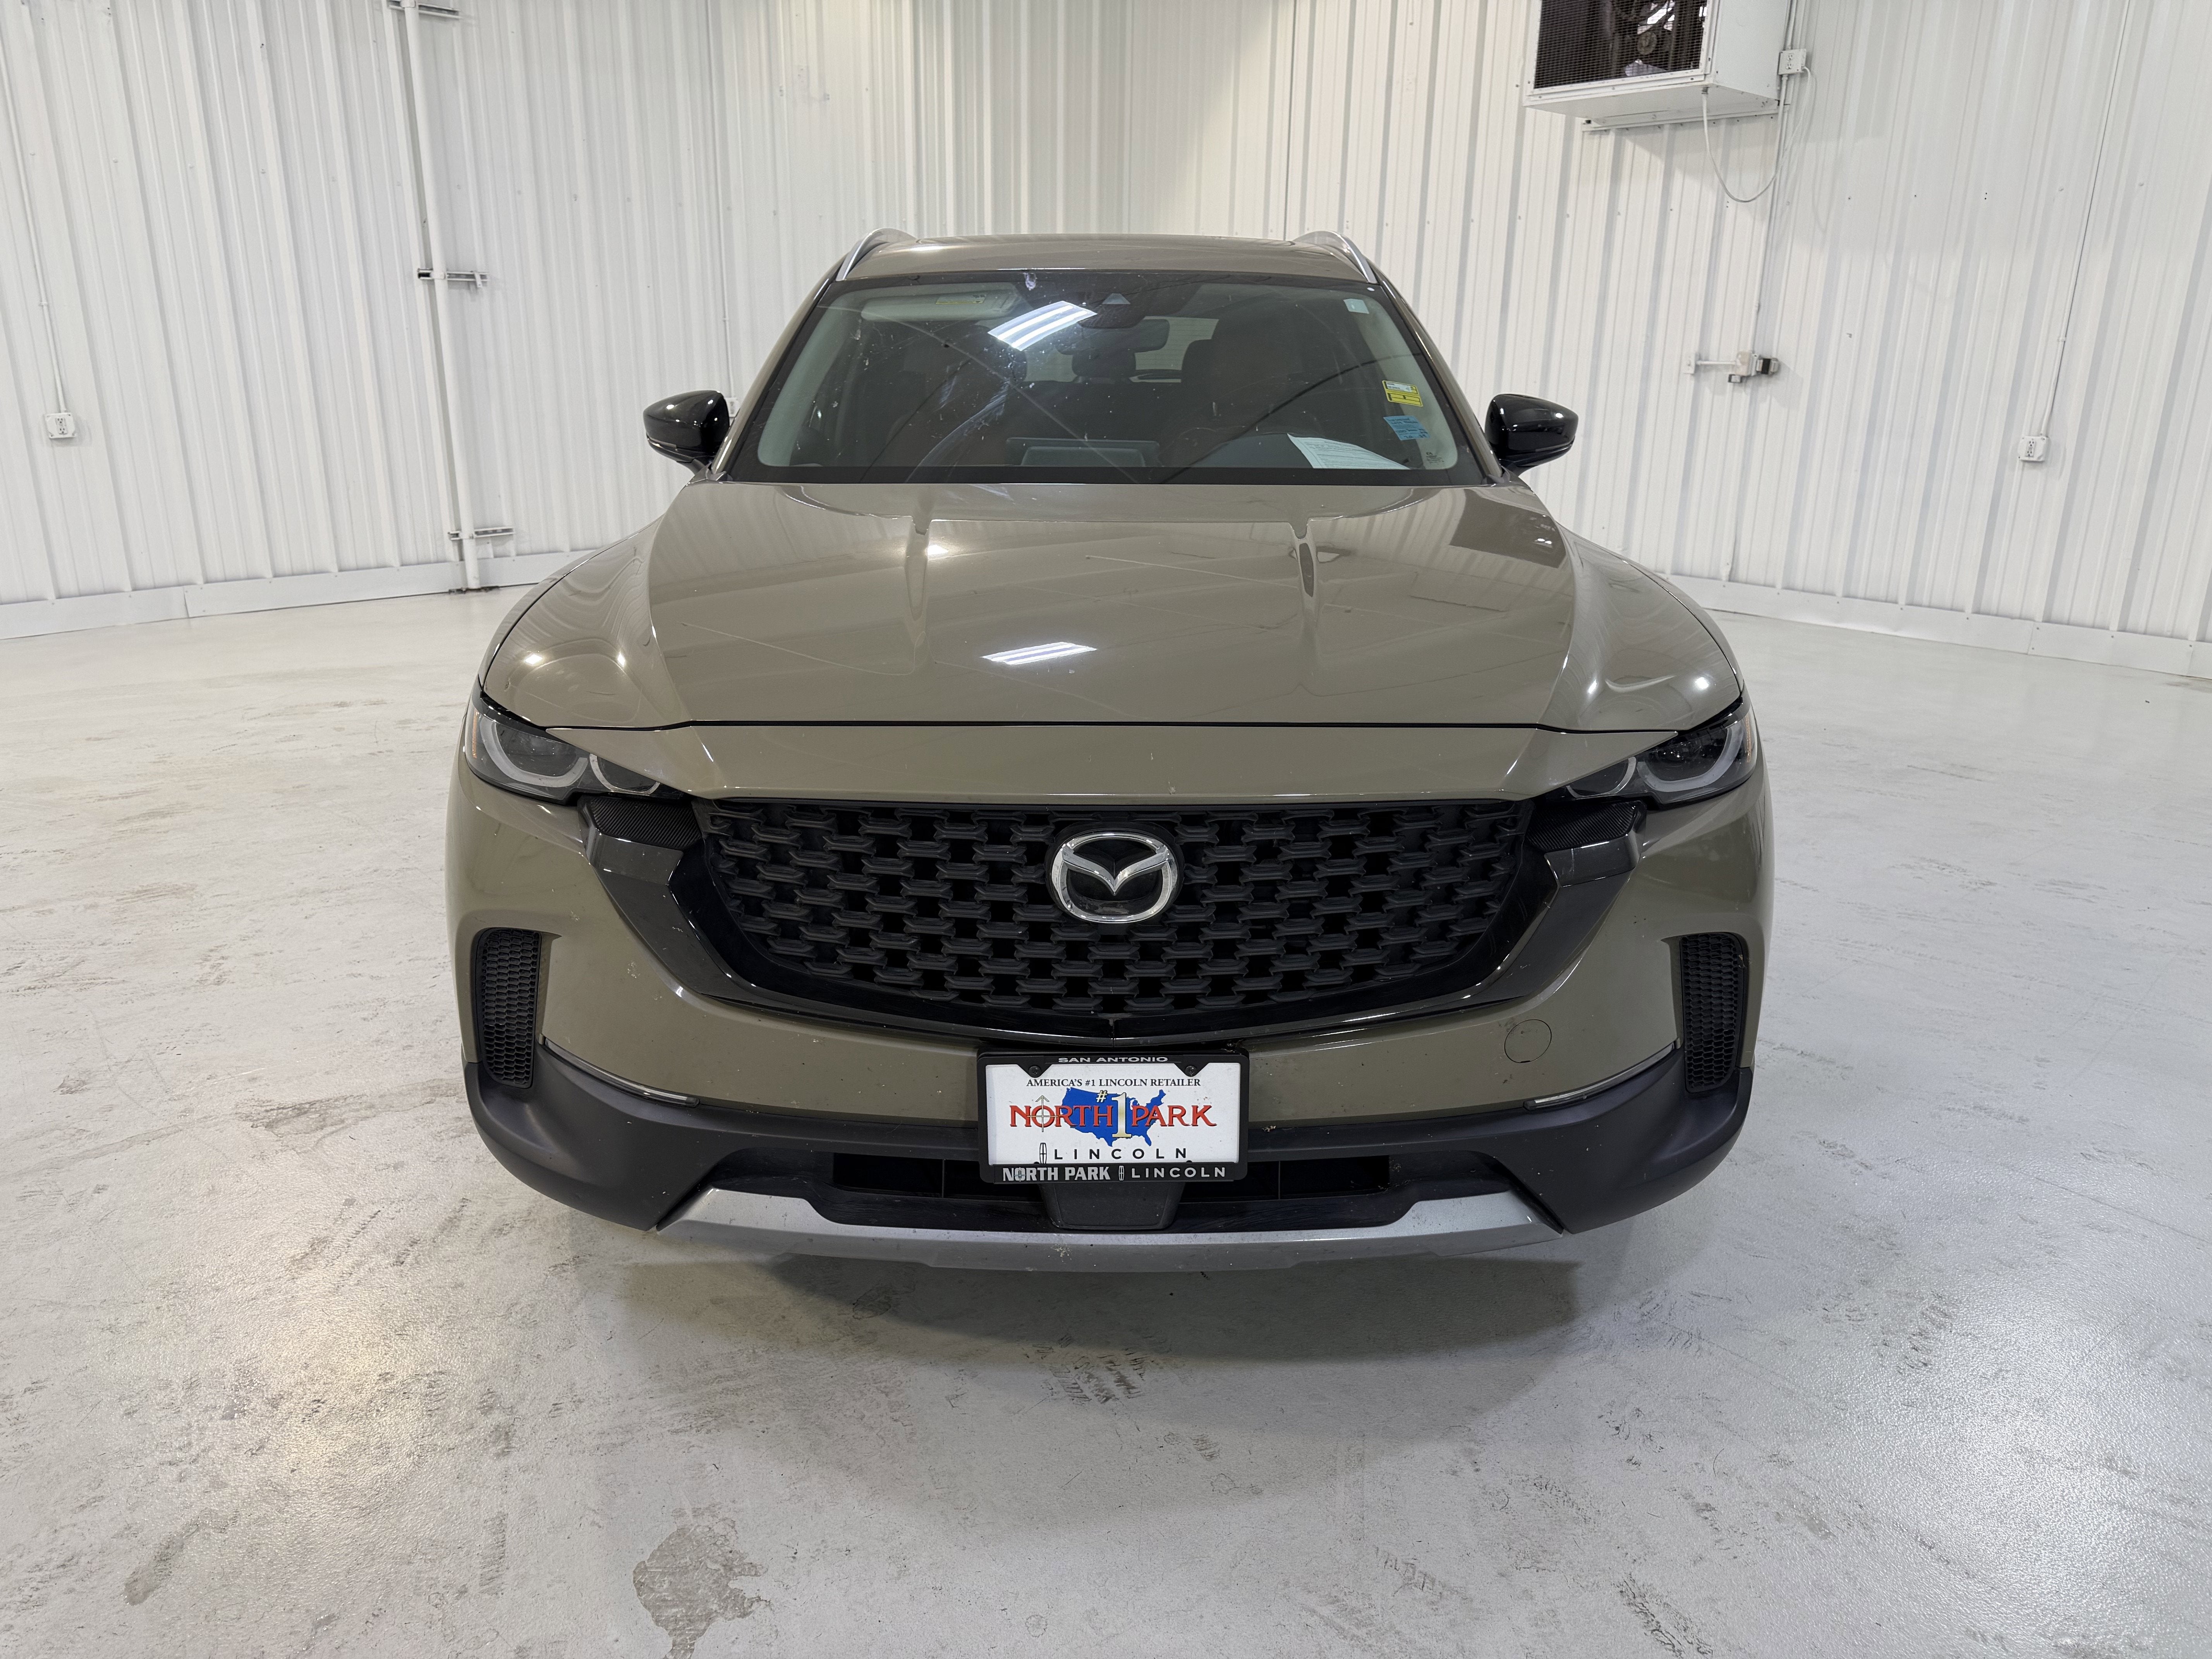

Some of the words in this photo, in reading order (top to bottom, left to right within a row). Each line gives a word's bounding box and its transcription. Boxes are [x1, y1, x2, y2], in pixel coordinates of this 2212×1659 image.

[1026, 1079, 1082, 1087] AMERICA'S
[1099, 1079, 1147, 1087] LINCOLN
[1009, 1105, 1113, 1127] NORTH
[1131, 1105, 1218, 1127] PARK
[1054, 1148, 1186, 1160] LINCOLN
[1003, 1167, 1058, 1182] NORTH
[1065, 1166, 1111, 1180] PARK
[1132, 1167, 1225, 1178] LINCOLN
